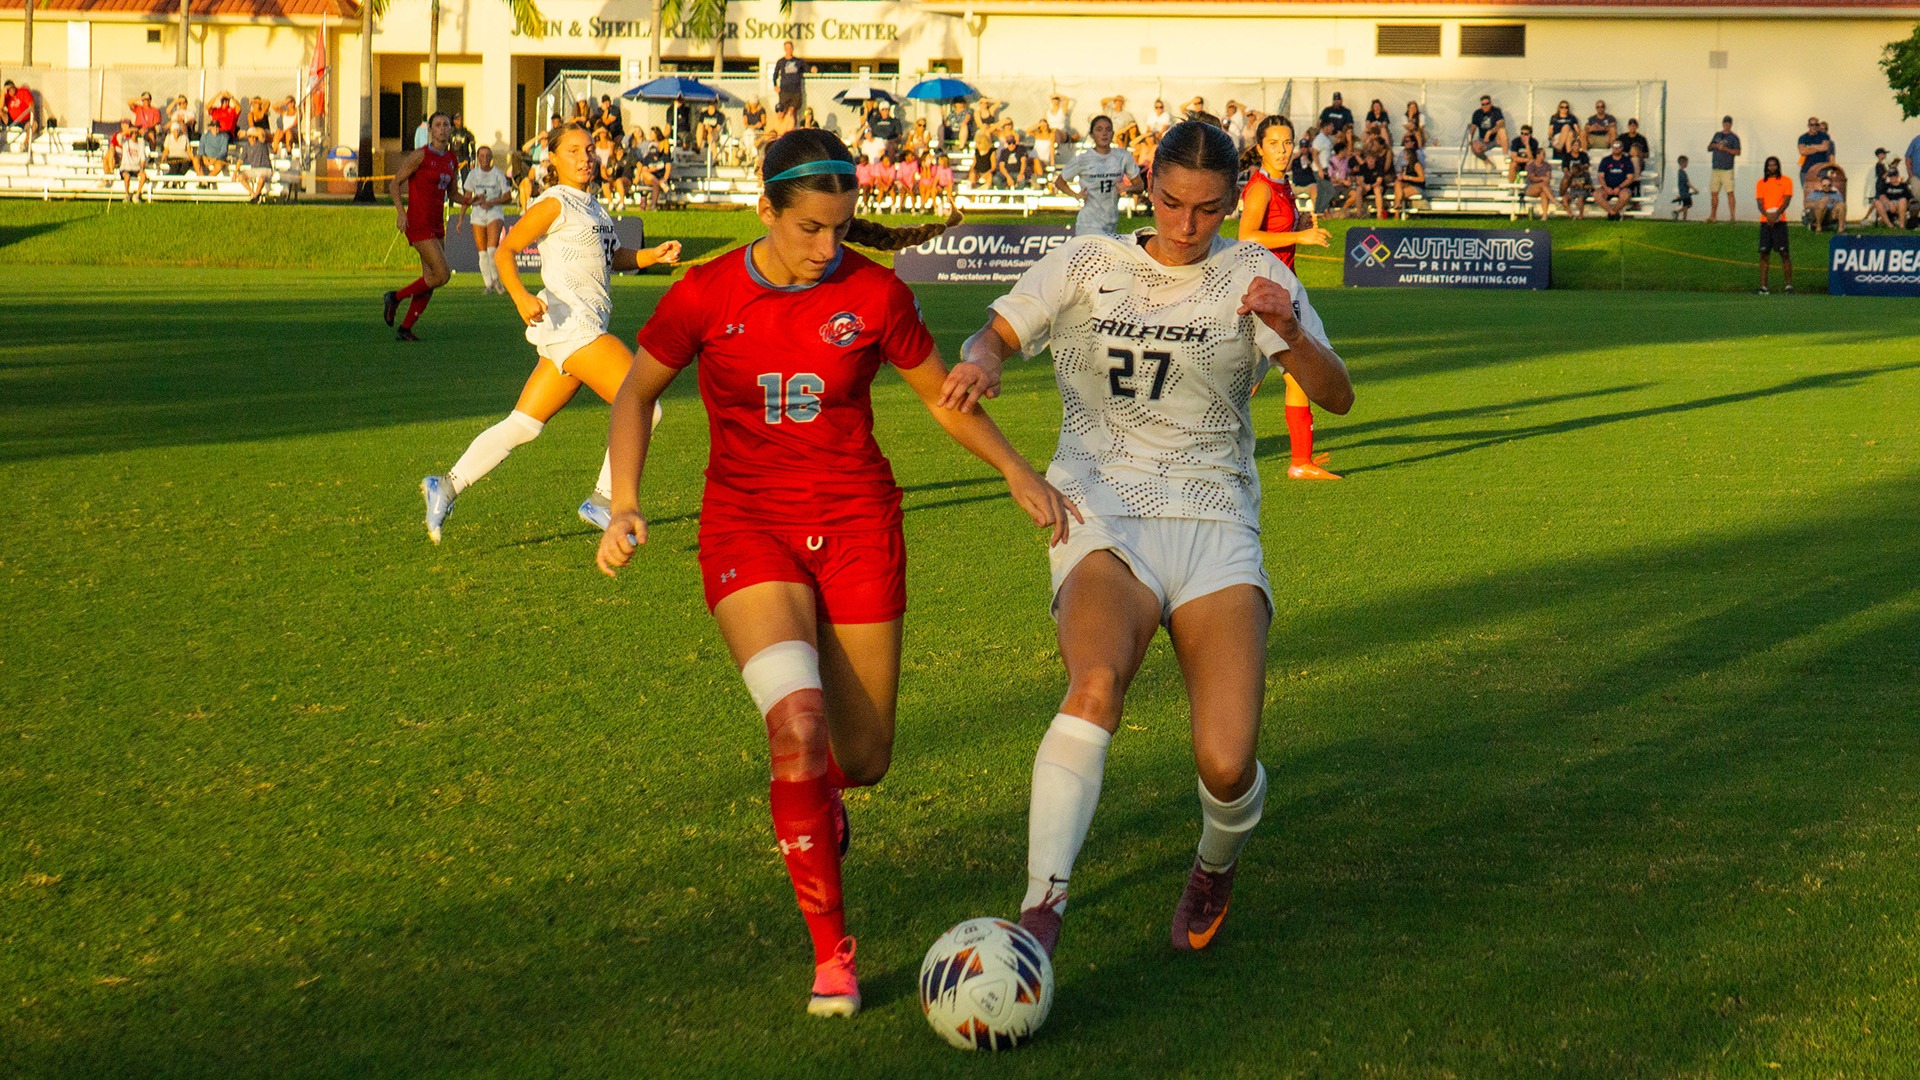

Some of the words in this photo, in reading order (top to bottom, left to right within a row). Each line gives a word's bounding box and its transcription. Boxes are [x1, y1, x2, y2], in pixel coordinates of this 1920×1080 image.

[511, 16, 562, 37] JON
[568, 20, 582, 37] &
[588, 16, 652, 38] SHEIL
[663, 18, 740, 39] RIR
[745, 17, 815, 40] SPORTS
[821, 18, 898, 41] CENTER
[1100, 180, 1113, 194] 13
[1001, 243, 1020, 254] the
[1020, 236, 1071, 255] 'FIS
[1394, 237, 1534, 261] AUTHENTIC
[1419, 261, 1507, 272] PRINTING
[1833, 249, 1886, 271] PALM
[938, 272, 949, 280] No
[950, 272, 991, 281] Spectators
[992, 272, 1021, 282] Beyond
[1399, 274, 1527, 285] AUTHENTICPRINTING.COM
[1108, 347, 1171, 400] 27
[757, 373, 825, 424] 16
